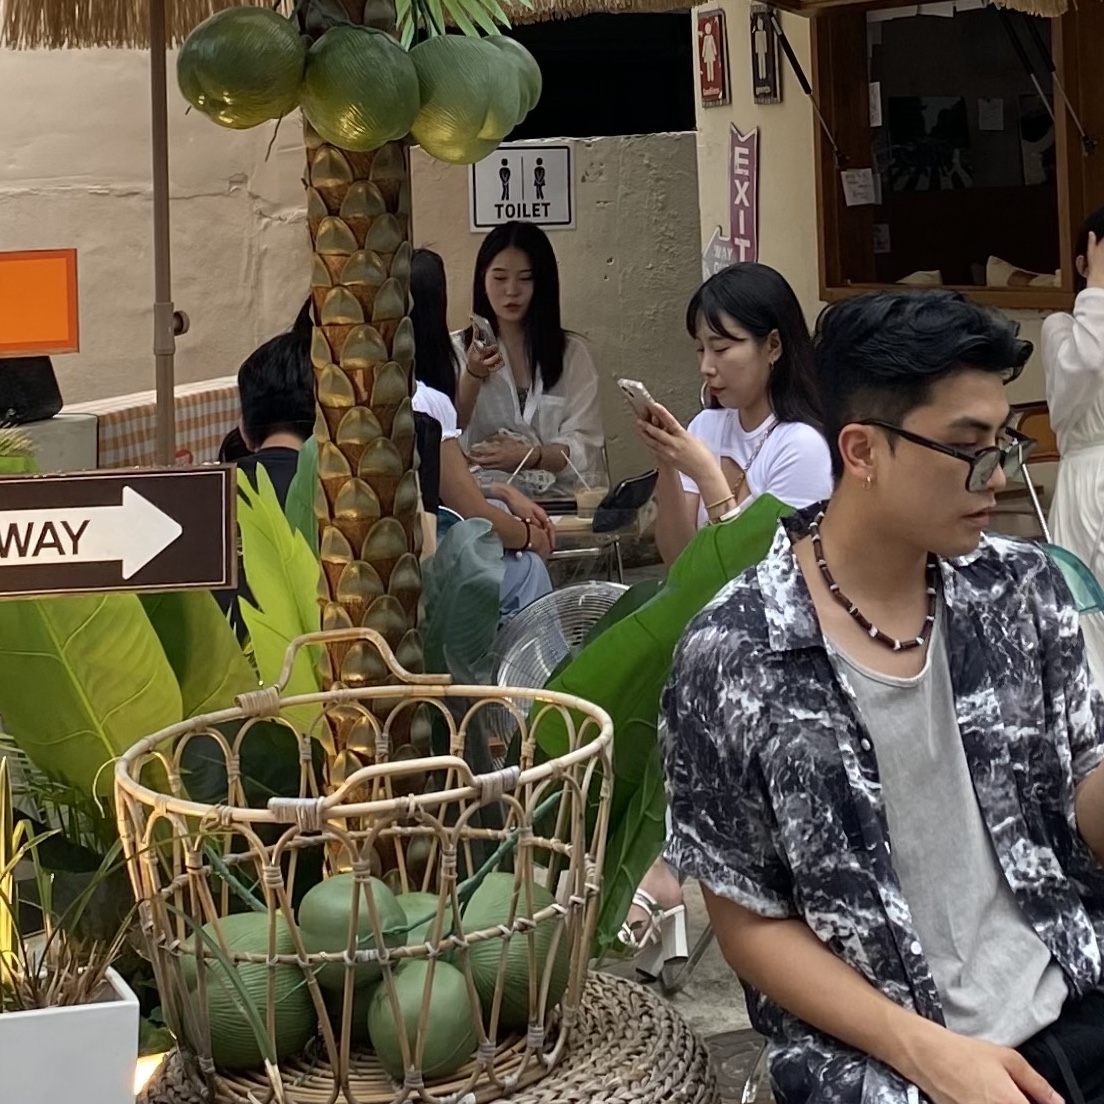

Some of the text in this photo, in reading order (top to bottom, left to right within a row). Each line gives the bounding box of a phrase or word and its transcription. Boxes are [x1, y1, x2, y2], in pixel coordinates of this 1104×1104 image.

[494, 202, 551, 219] TOILET
[734, 146, 751, 263] EXIT
[714, 244, 734, 261] WAY
[0, 519, 91, 558] WAY
